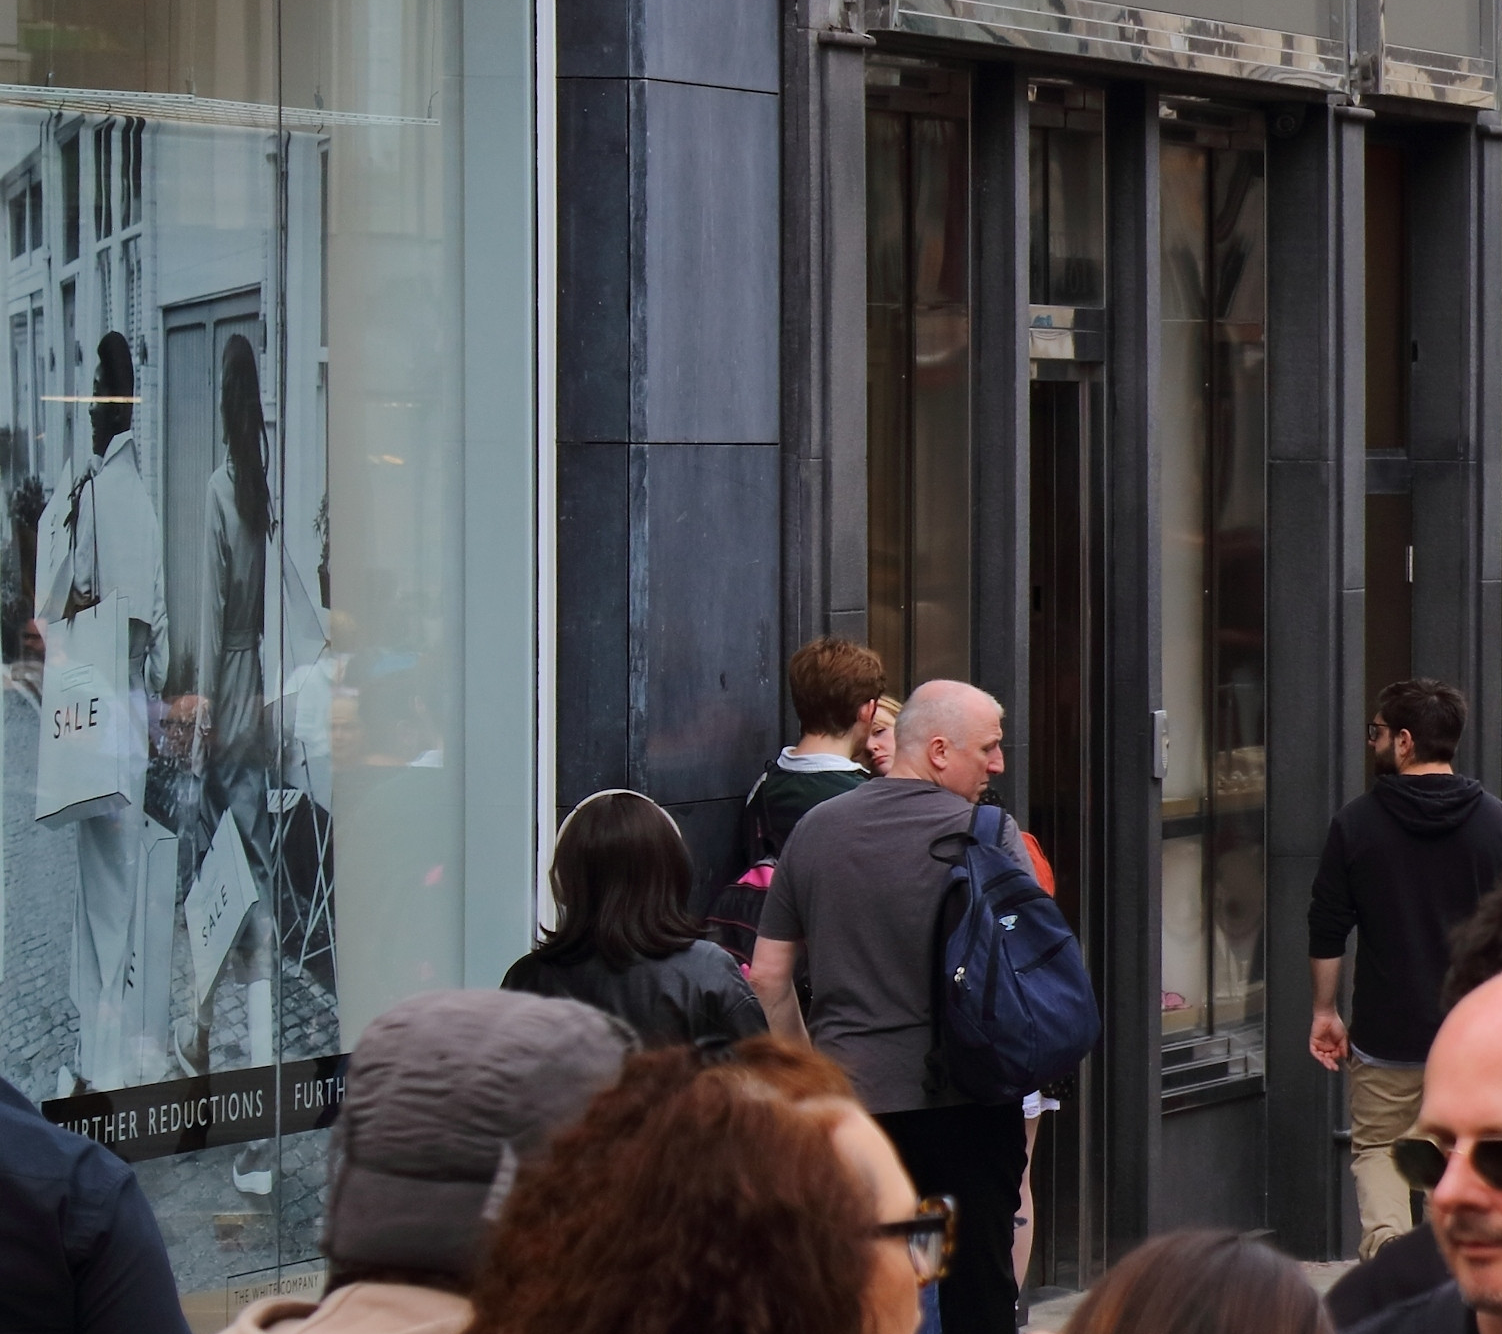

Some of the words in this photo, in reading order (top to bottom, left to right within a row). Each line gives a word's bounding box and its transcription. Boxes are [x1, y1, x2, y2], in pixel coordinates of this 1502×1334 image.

[53, 697, 100, 740] SALE
[201, 884, 227, 947] SALE
[148, 1089, 264, 1136] REDUCTIONS
[294, 1076, 347, 1111] FURTH
[234, 1288, 250, 1305] THE
[252, 1282, 279, 1299] WHITE
[280, 1274, 319, 1296] COMPANY
